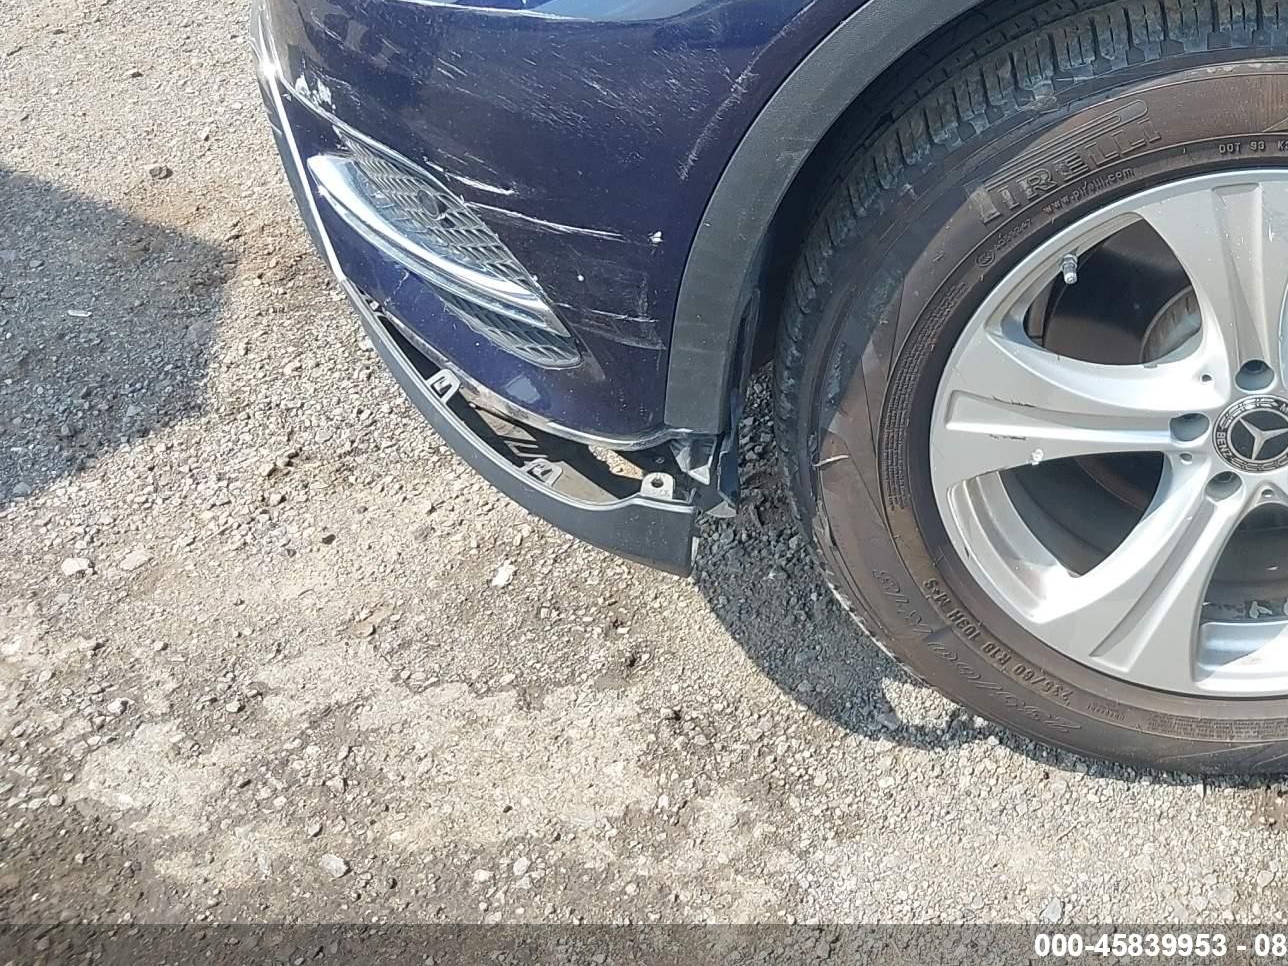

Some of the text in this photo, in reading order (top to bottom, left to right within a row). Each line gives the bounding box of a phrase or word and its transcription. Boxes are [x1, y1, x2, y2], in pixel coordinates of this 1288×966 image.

[968, 100, 1161, 224] PIRELLI
[1218, 142, 1242, 154] DOT
[1042, 166, 1136, 215] www.pirelli.com
[1216, 431, 1233, 459] BENZ
[946, 607, 981, 641] 103H
[981, 641, 1012, 667] R18
[1013, 663, 1074, 702] 235/60
